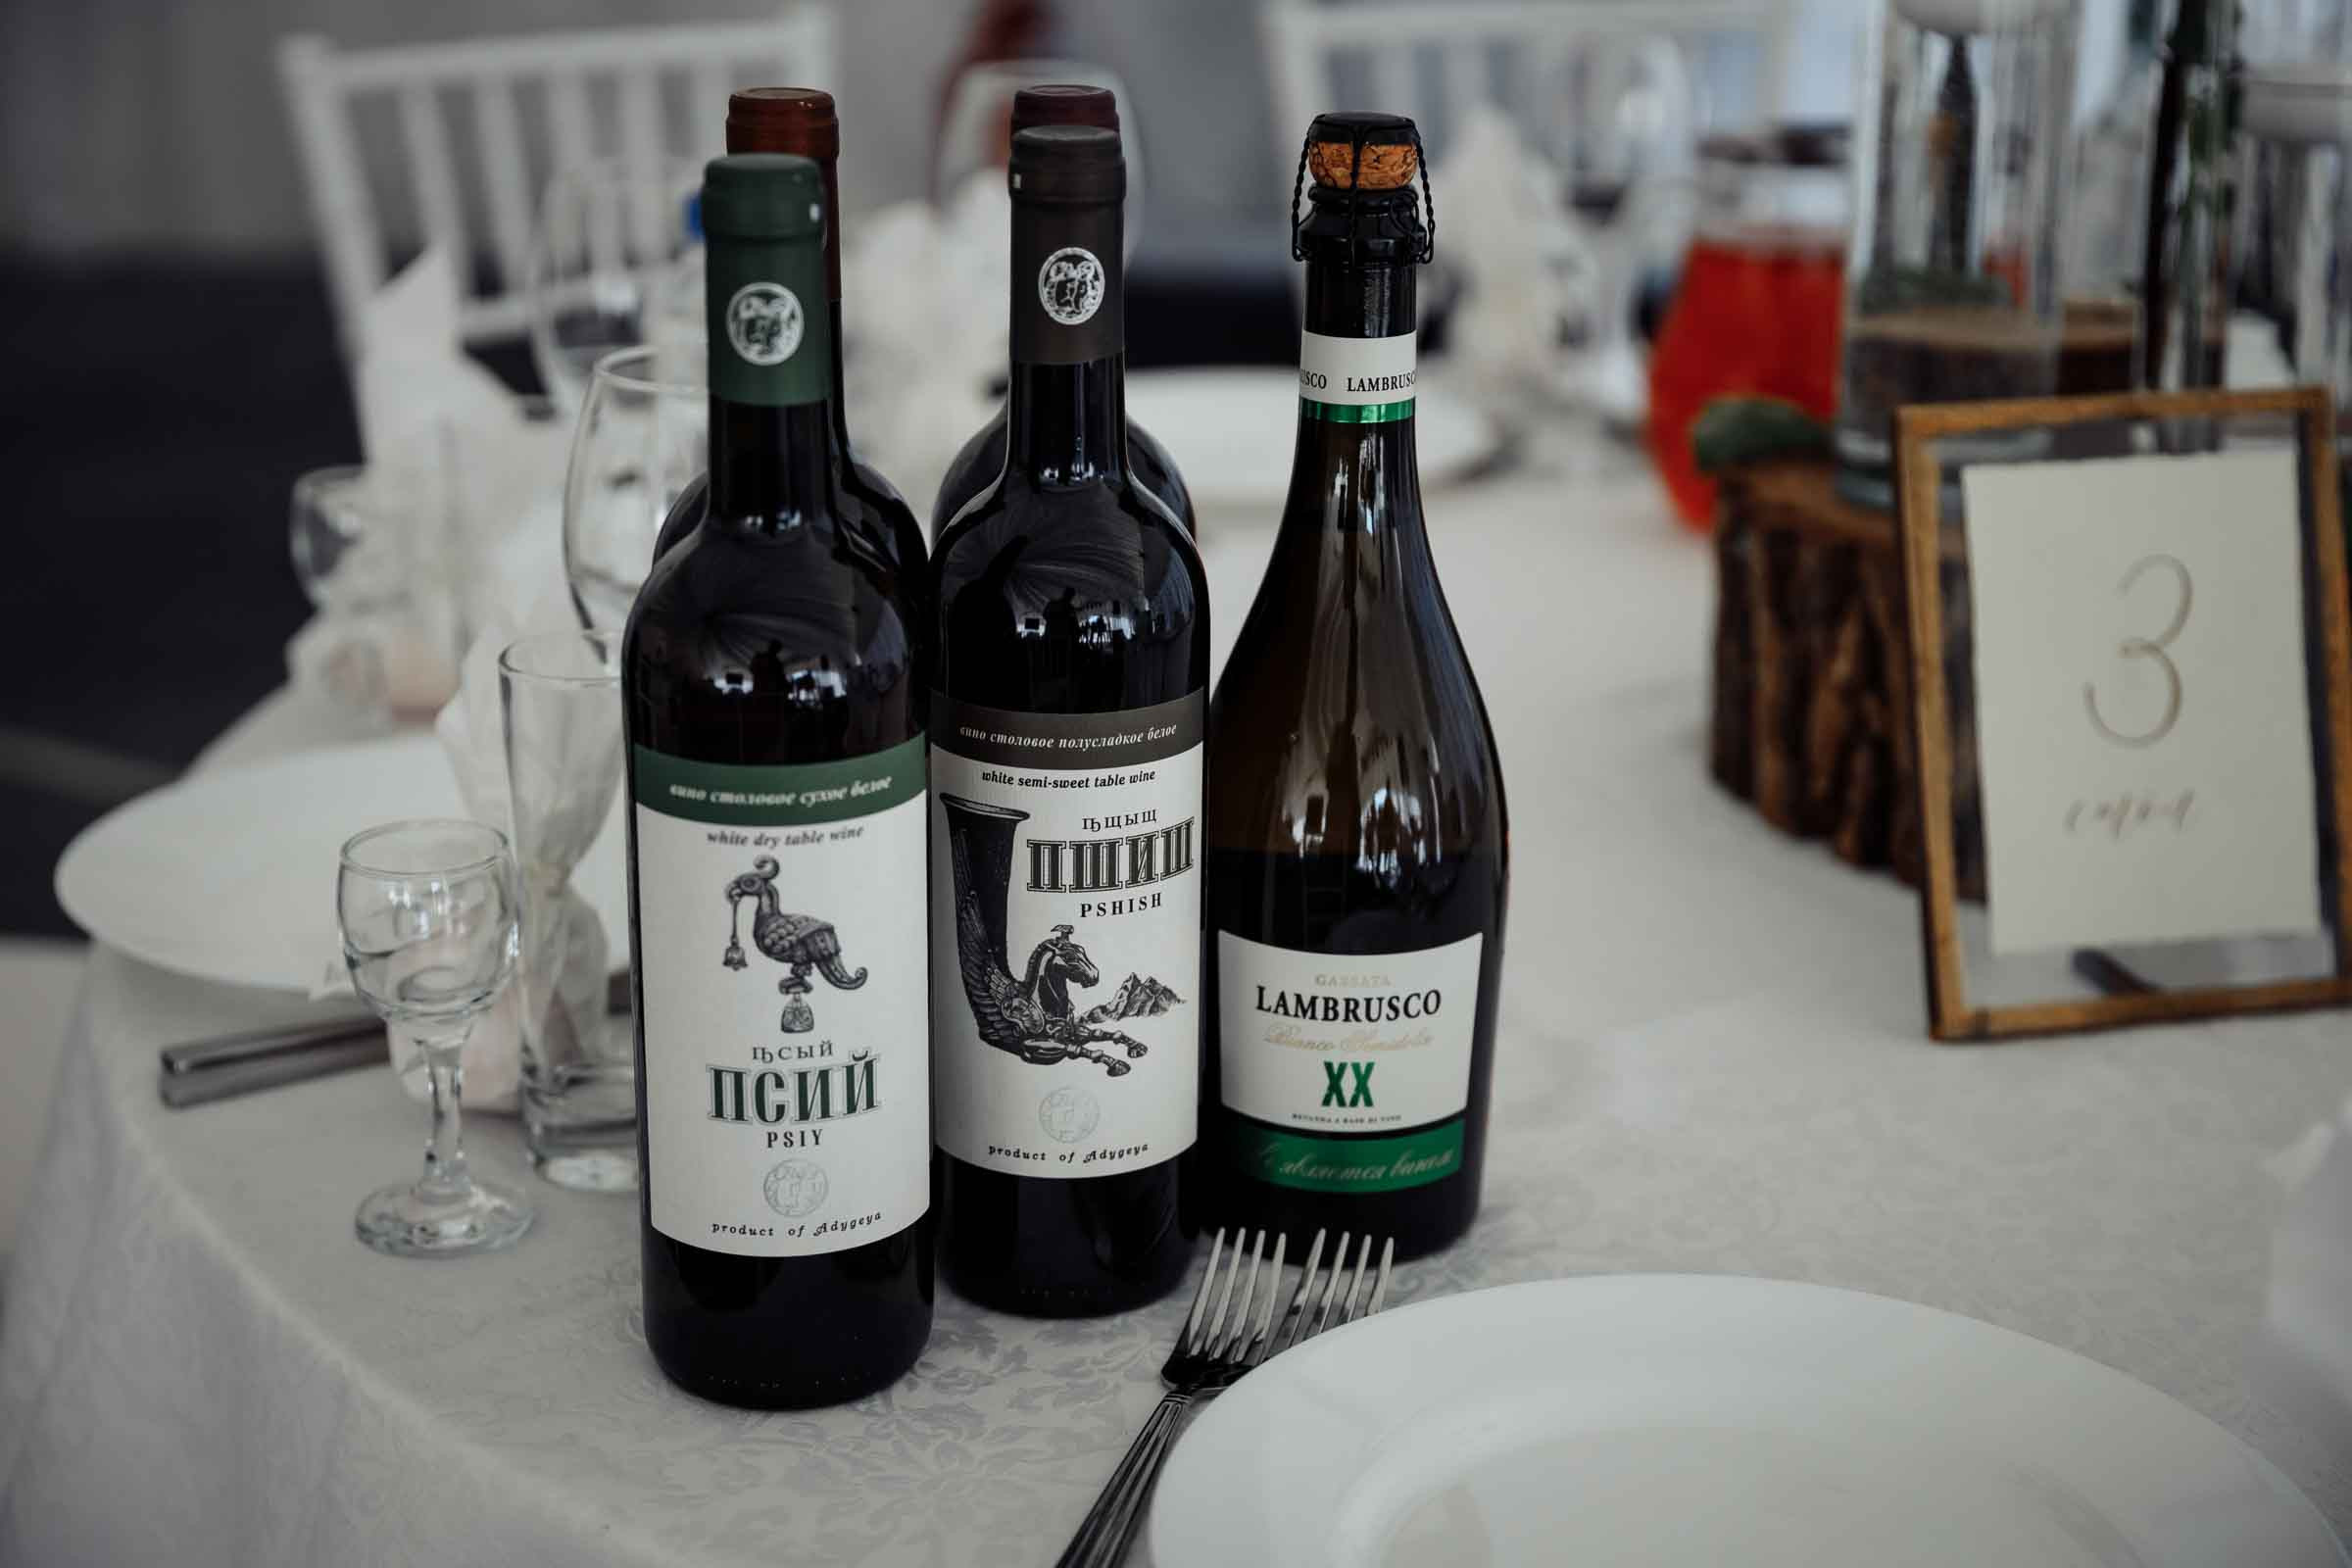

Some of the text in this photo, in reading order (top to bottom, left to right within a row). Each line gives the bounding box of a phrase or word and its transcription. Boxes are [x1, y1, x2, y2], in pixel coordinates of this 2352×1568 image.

[1347, 370, 1417, 392] LAMBRUSC
[2082, 553, 2193, 747] 3
[959, 724, 1177, 752] вино столовое полусладкое белое
[982, 769, 1155, 789] white semi-sweet table wine
[707, 826, 864, 849] white dry table wine
[1027, 816, 1195, 894] ПШИШ
[1081, 892, 1162, 917] PSHISH
[1255, 984, 1442, 1023] LAMBRUSCO
[708, 1049, 881, 1124] ПСИЙ
[1321, 1061, 1375, 1107] XX
[767, 1129, 823, 1148] PSIY
[988, 1144, 1149, 1163] product of Adygeya
[711, 1211, 882, 1237] product of Adygeya
